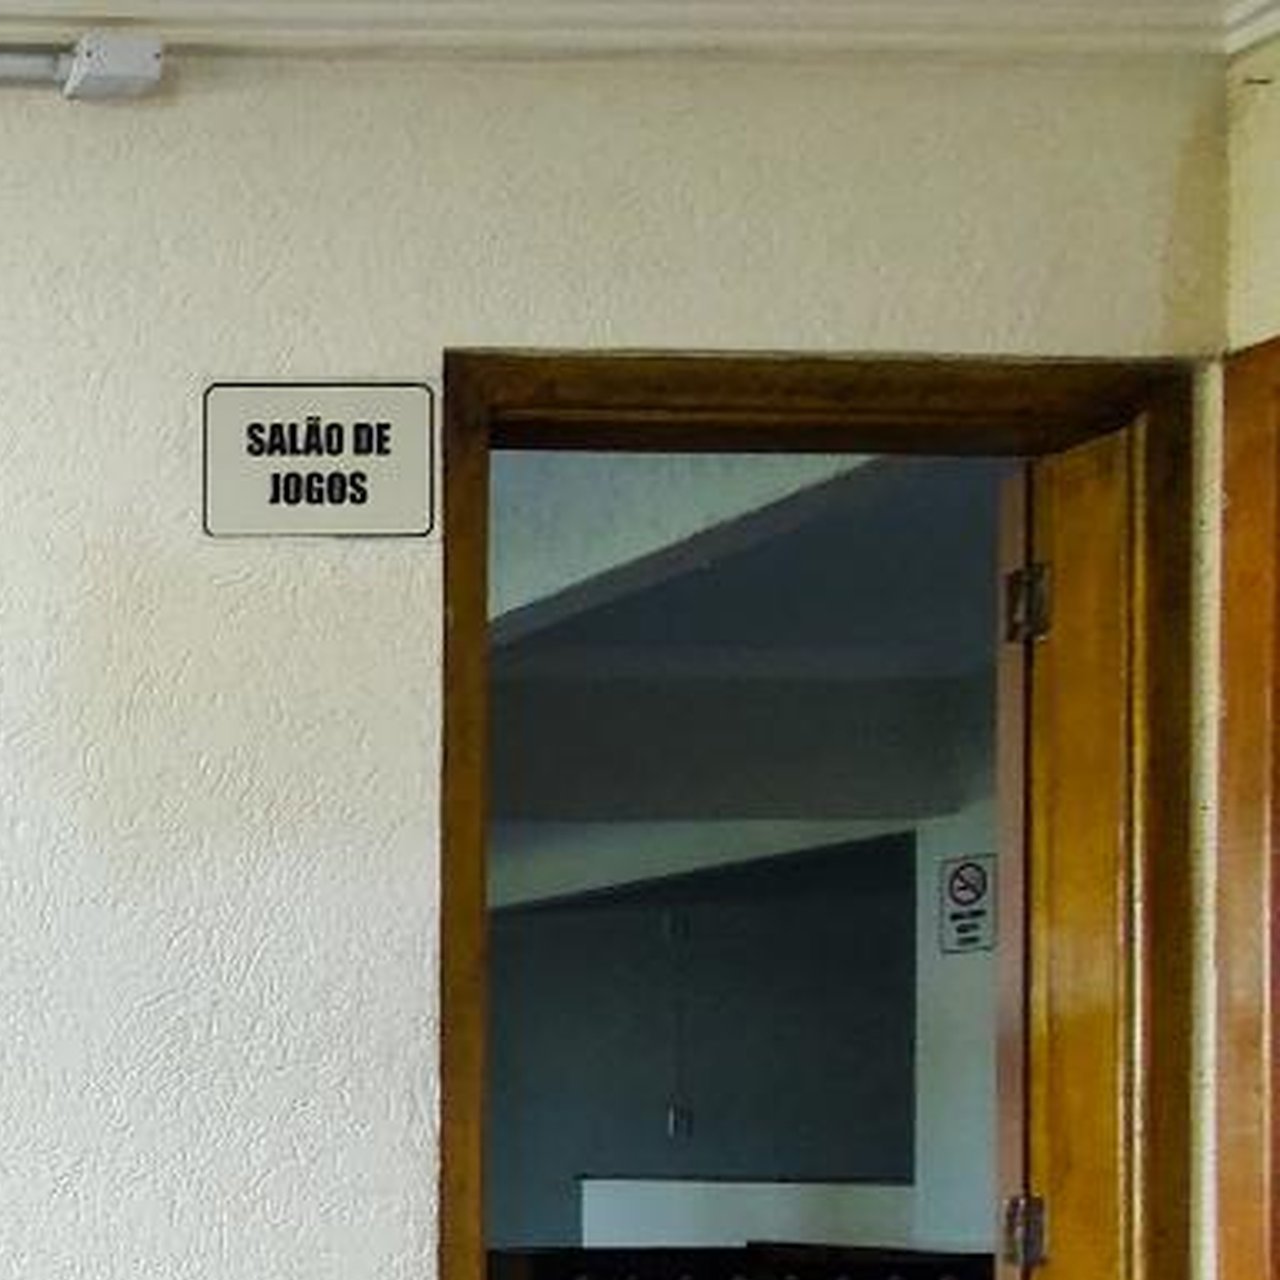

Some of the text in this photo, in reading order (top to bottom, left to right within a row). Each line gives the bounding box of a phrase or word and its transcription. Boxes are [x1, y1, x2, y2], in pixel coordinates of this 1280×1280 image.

[246, 416, 392, 457] SALÃO DE
[269, 471, 368, 505] JOGOS
